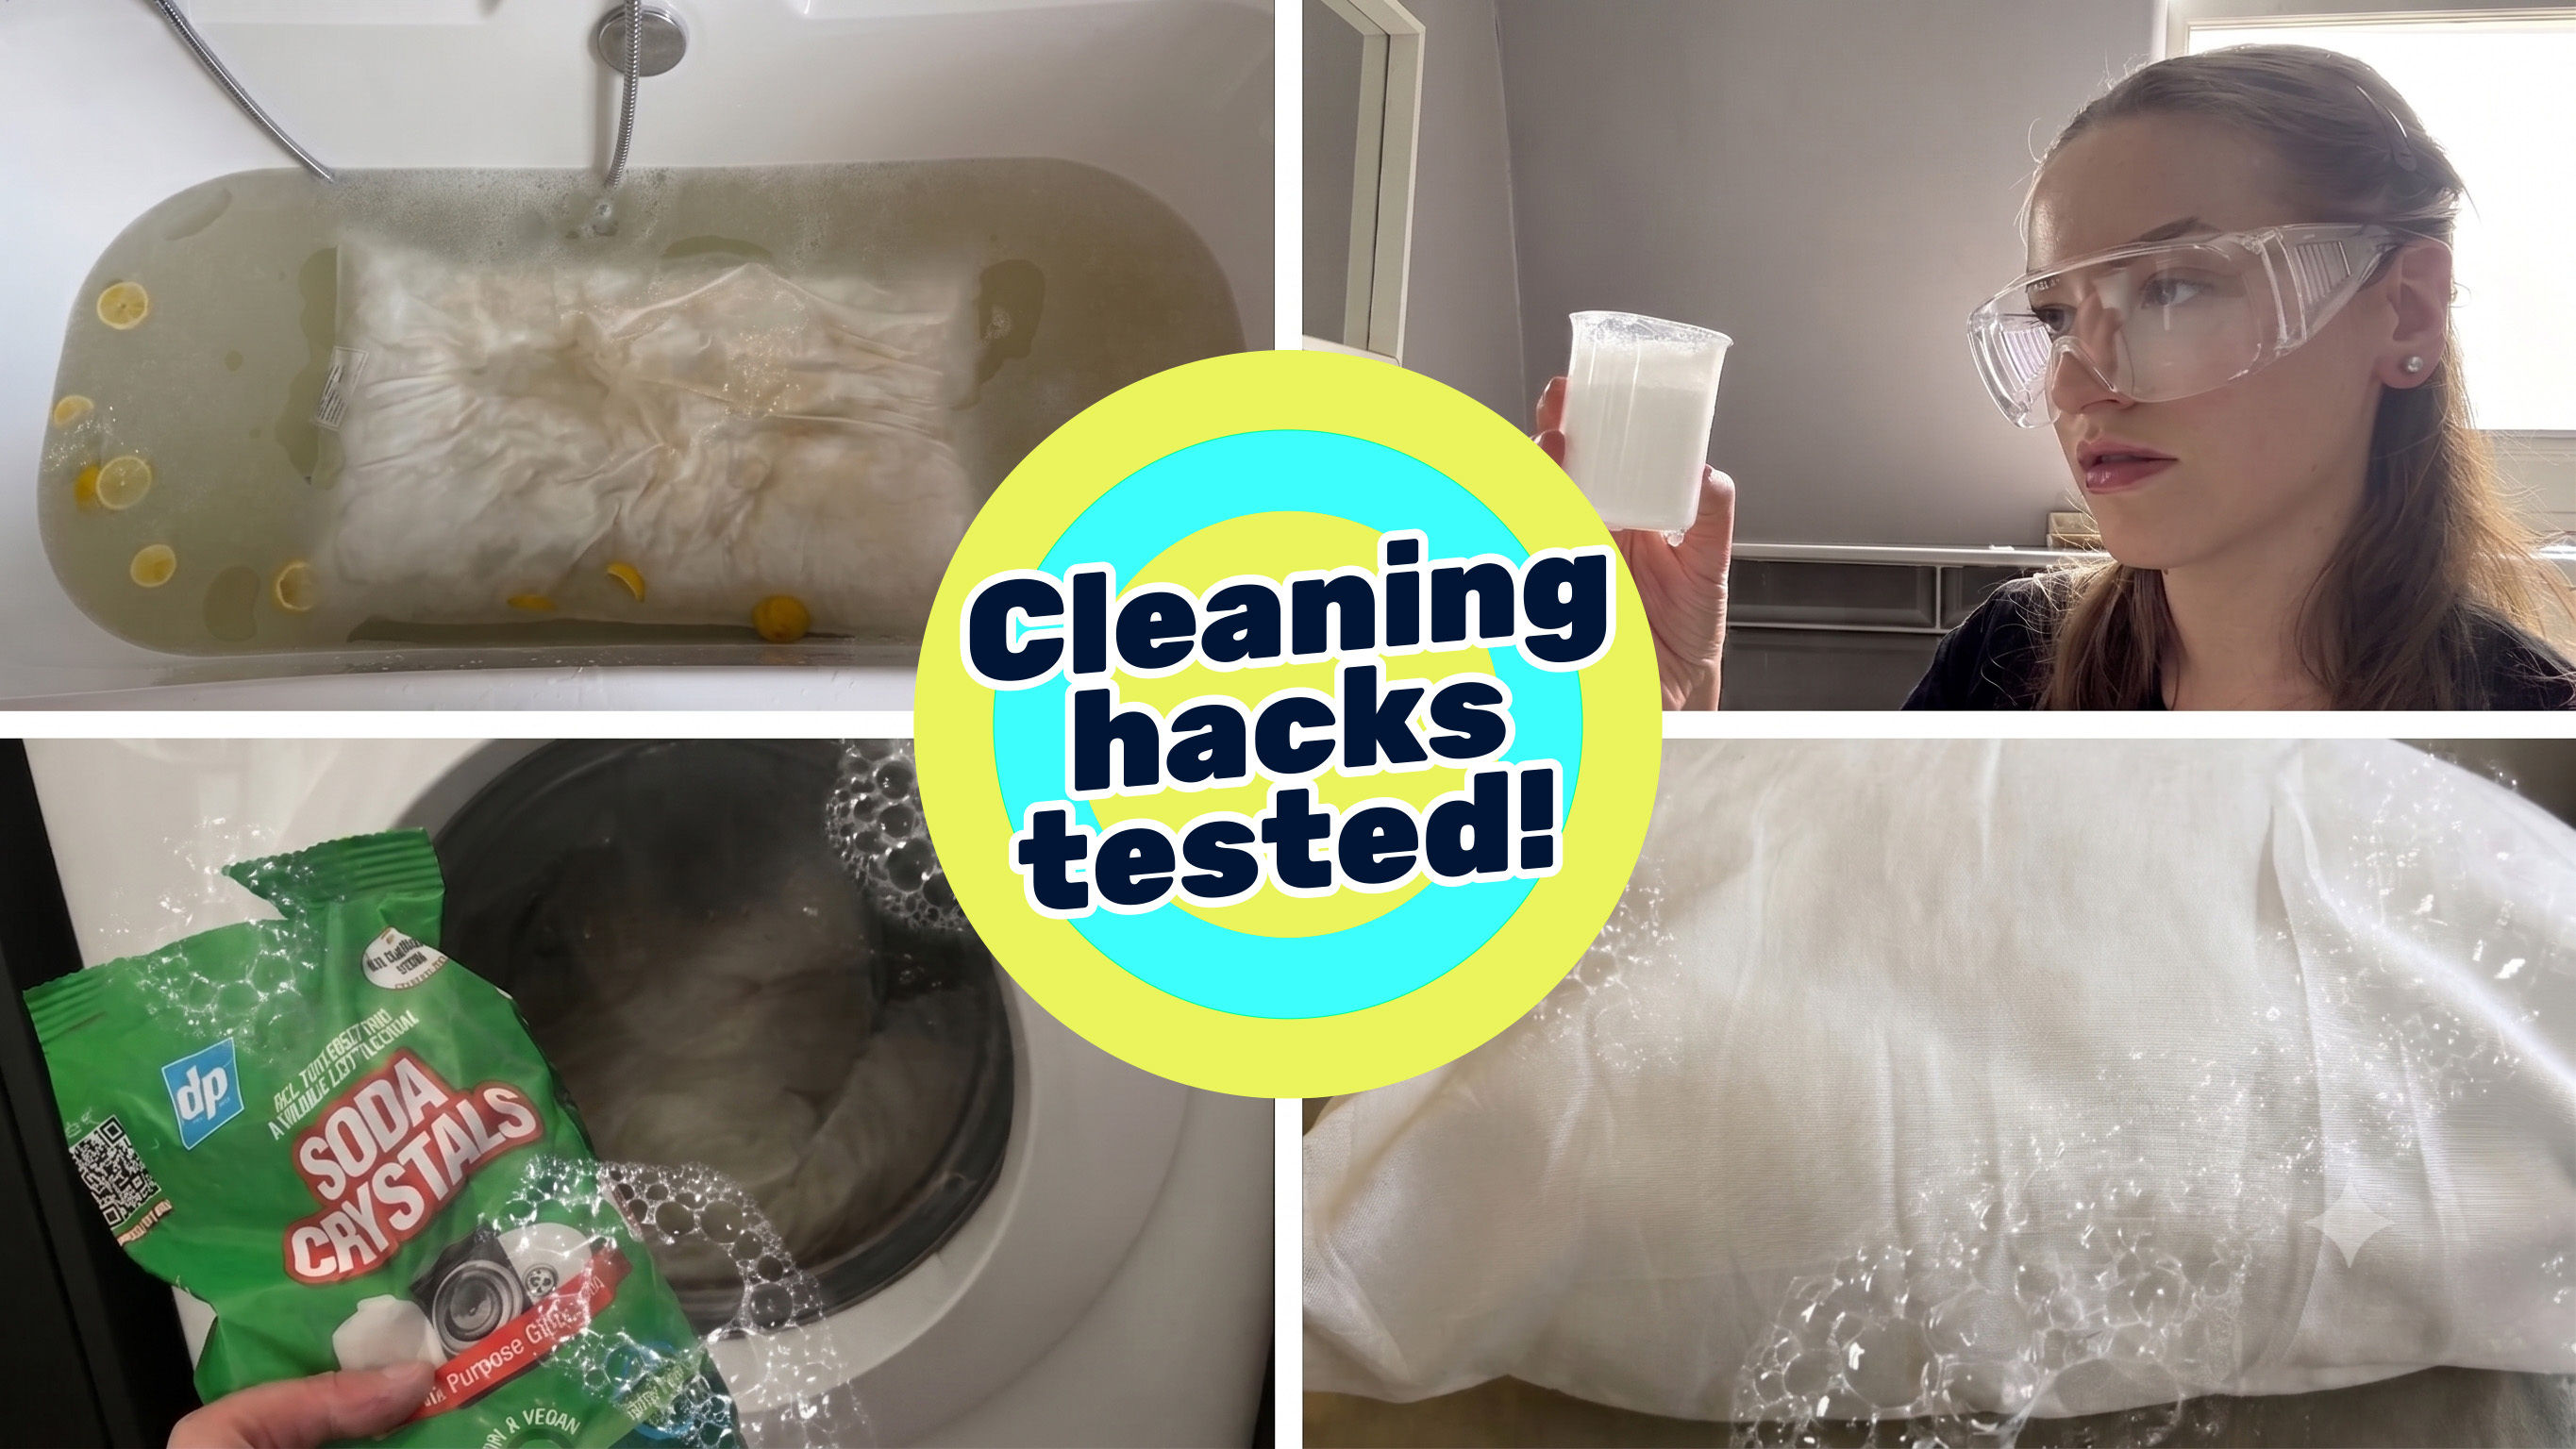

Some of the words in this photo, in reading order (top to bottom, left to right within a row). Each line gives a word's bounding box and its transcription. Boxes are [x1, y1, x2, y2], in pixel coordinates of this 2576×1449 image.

[176, 1064, 228, 1121] dp
[298, 1057, 449, 1201] SODA
[291, 1087, 537, 1277] CRYSTALS
[446, 1337, 525, 1394] Purpose
